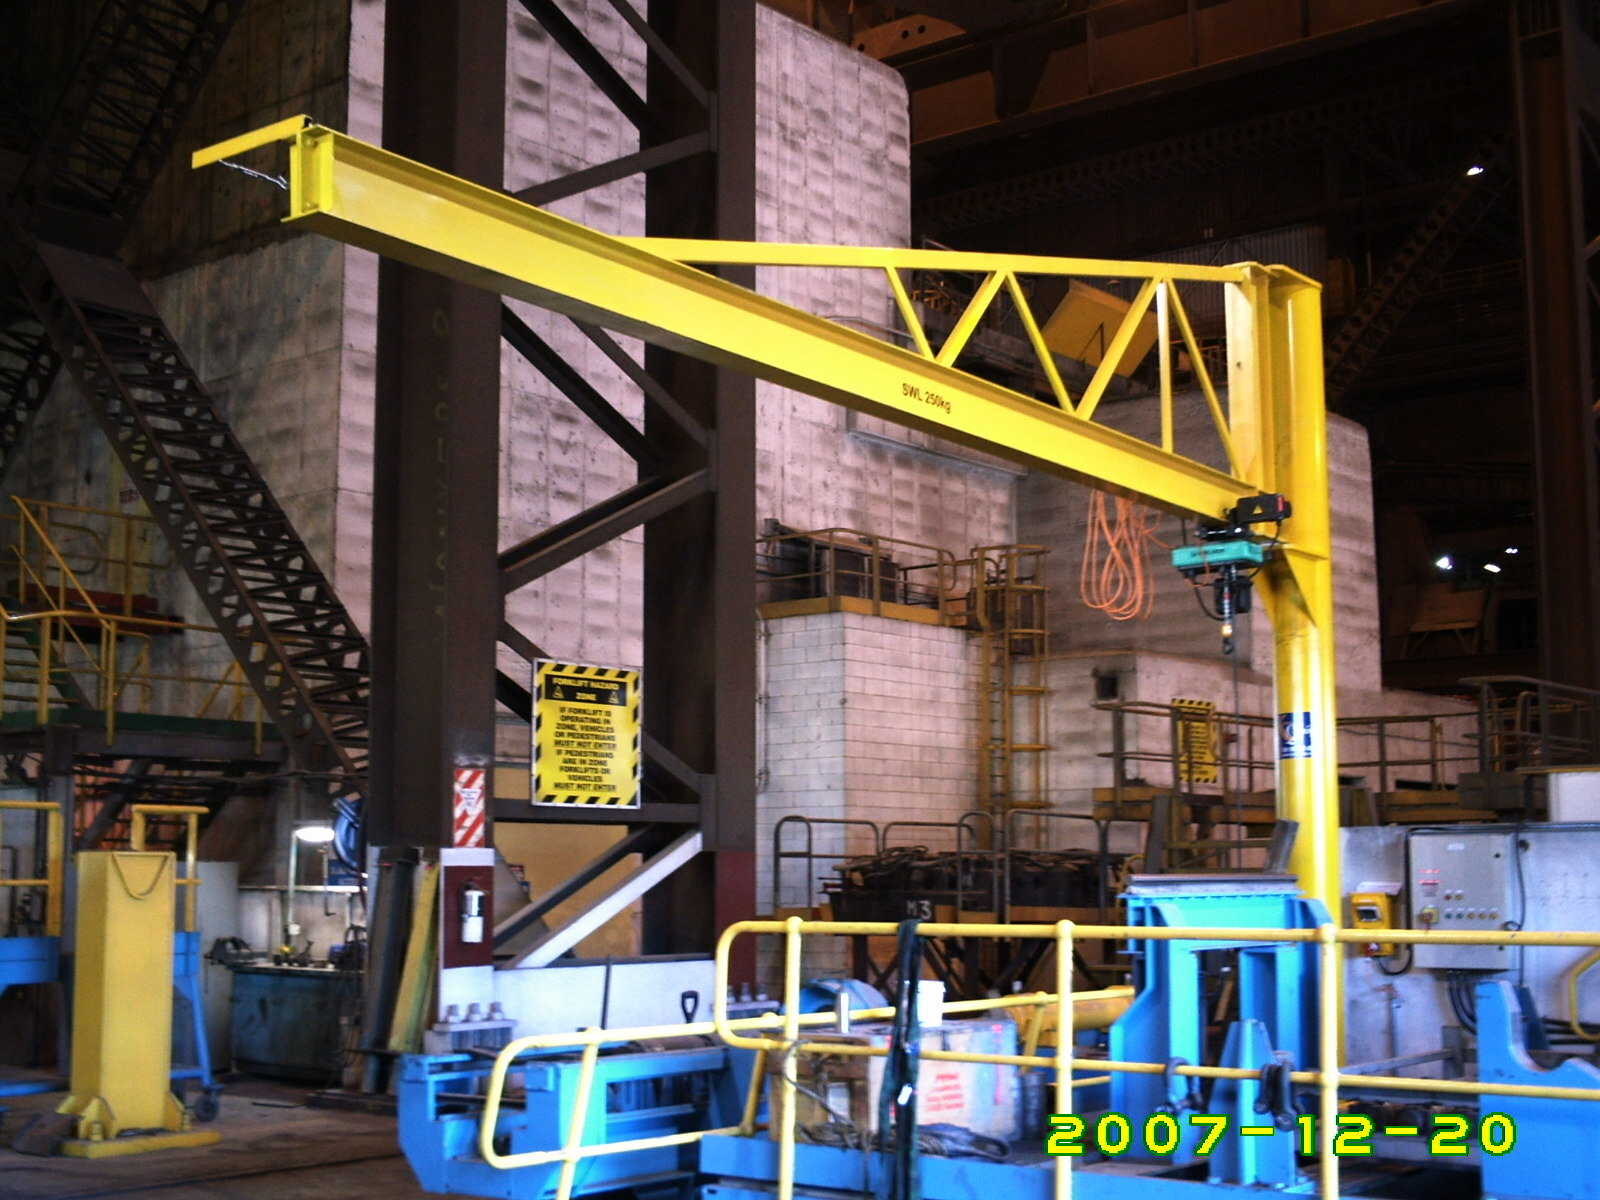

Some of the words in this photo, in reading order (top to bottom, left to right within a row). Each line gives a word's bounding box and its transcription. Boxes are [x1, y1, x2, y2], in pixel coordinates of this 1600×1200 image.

[902, 382, 923, 402] SWL
[925, 391, 951, 415] 250kg
[569, 707, 603, 716] FORKLIFT
[561, 715, 601, 724] OPERATING
[580, 725, 615, 733] VEHICLES
[567, 732, 616, 741] PEDESTRIANS
[554, 740, 575, 748] MUST
[577, 741, 592, 749] NOT
[565, 750, 614, 759] PEDESTRIANS
[553, 782, 575, 791] MUST
[577, 783, 592, 791] NOT
